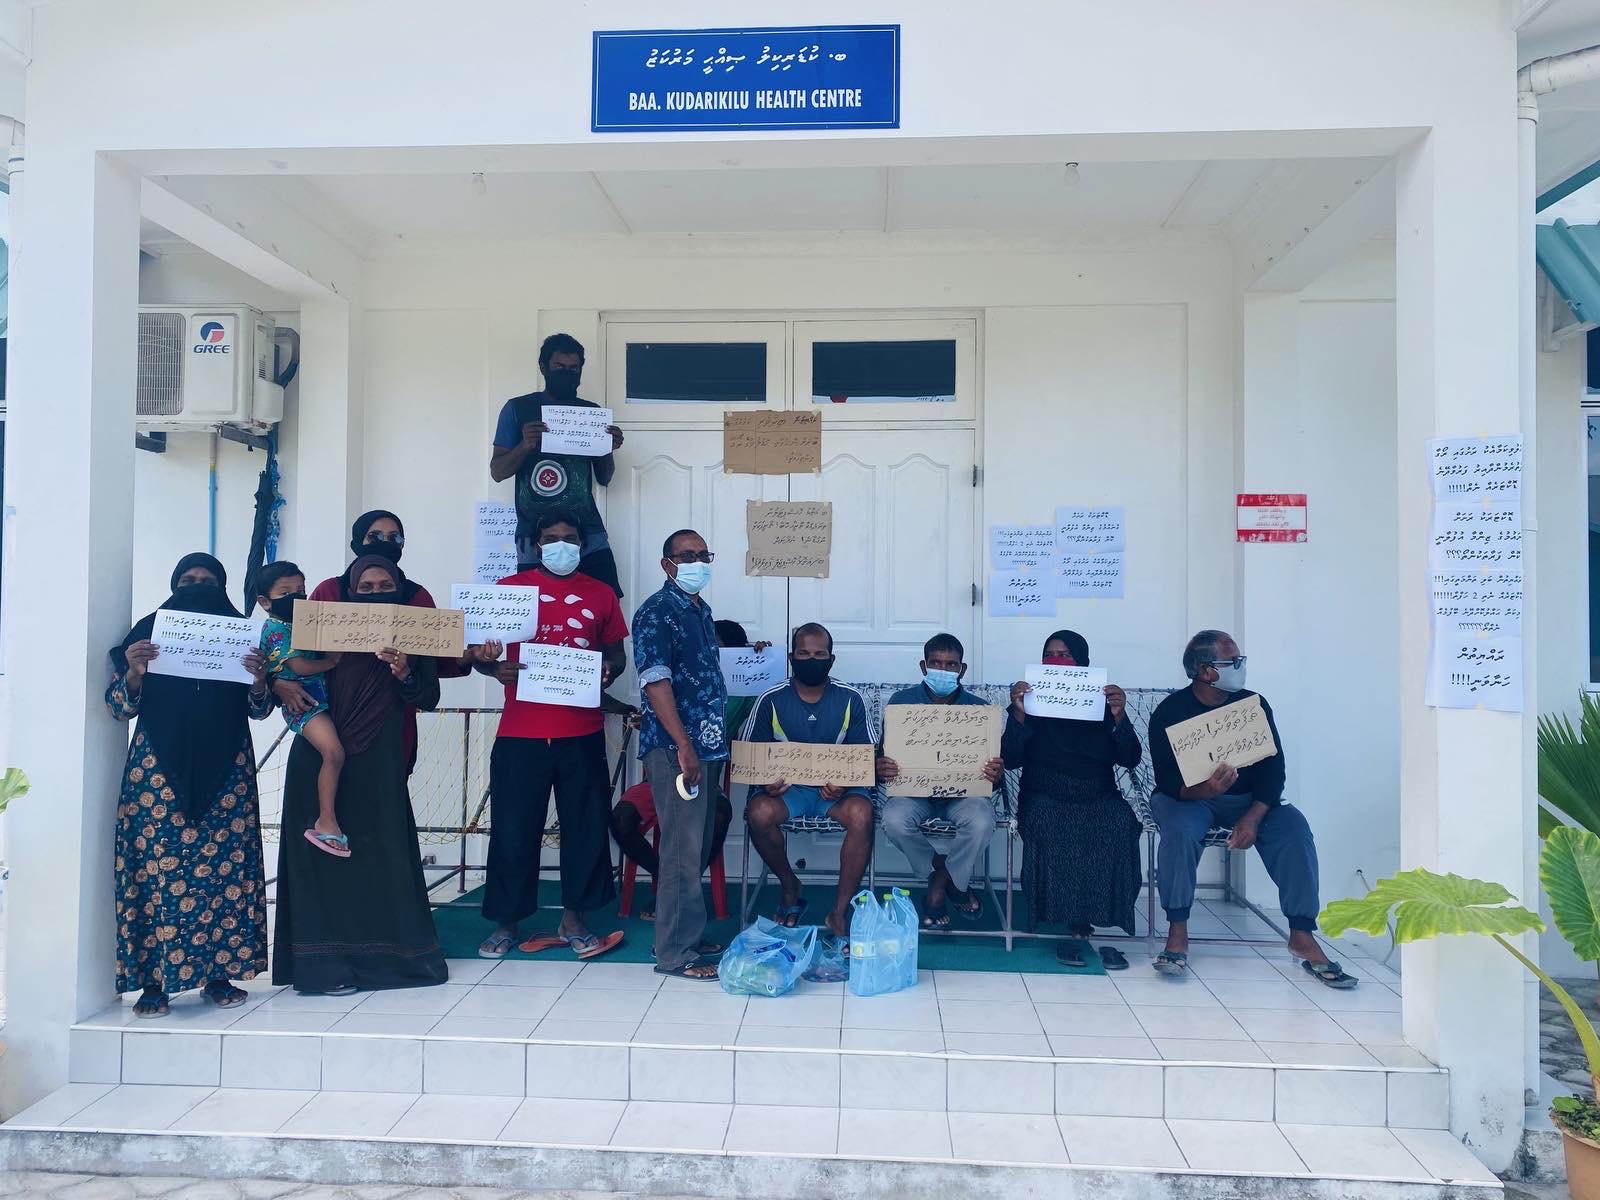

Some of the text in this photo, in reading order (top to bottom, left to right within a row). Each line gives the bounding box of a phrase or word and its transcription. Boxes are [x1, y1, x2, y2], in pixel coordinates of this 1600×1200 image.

[646, 49, 694, 67] މަރުކަޒު
[757, 45, 818, 70] ކުޑަރިކިލު
[629, 89, 862, 111] BAA. KUDARIKILU HEALTH CENTRE
[194, 345, 230, 353] GREE
[736, 656, 765, 668] ރައްޔިތުން
[1457, 647, 1505, 665] ރައްޔިތުން
